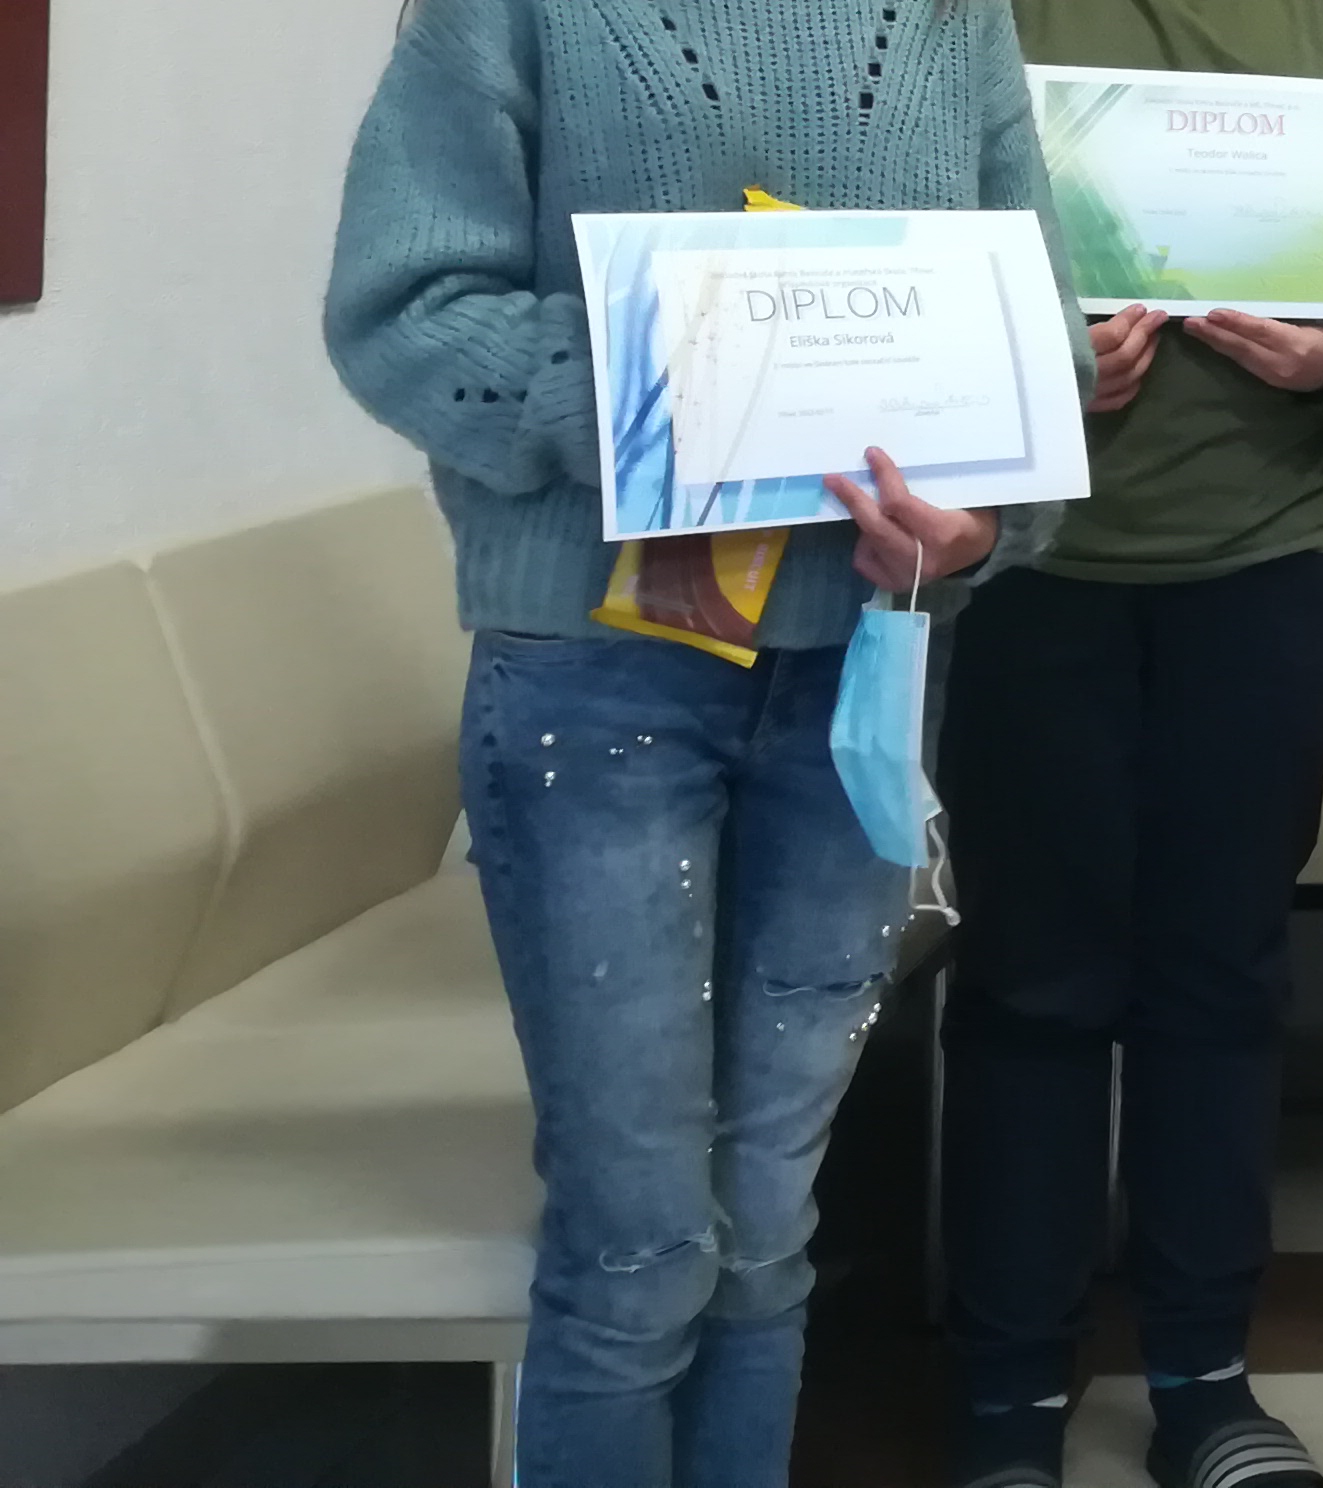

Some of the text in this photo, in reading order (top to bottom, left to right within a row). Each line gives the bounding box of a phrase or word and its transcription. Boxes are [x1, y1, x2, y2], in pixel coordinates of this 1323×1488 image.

[1166, 109, 1286, 136] DIPLOM
[1188, 148, 1228, 159] Teodor
[746, 286, 921, 322] DIPLOM
[789, 332, 895, 348] Eliška Sikorová
